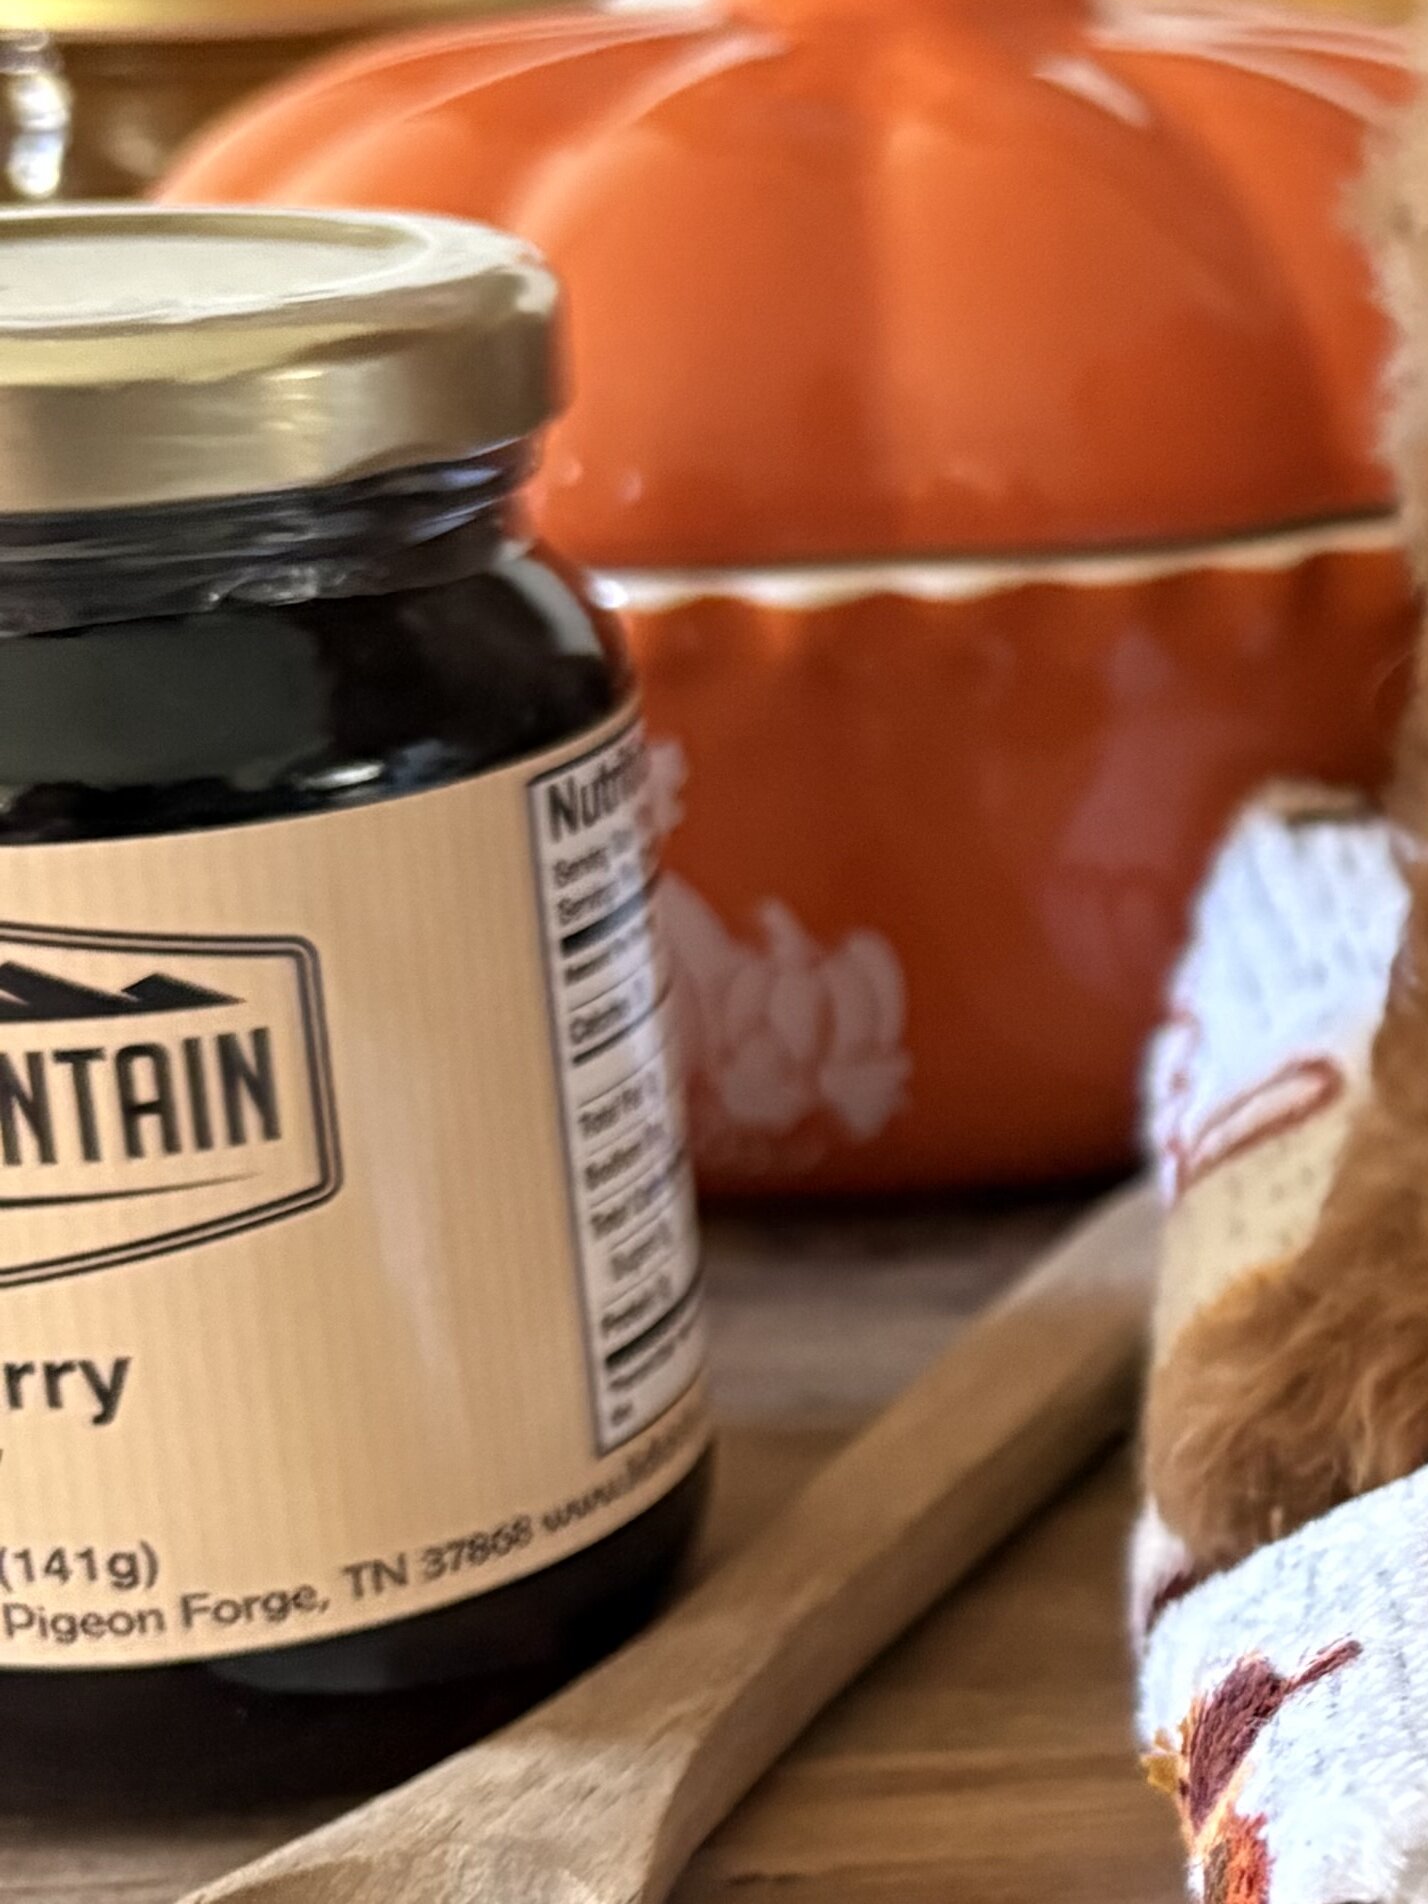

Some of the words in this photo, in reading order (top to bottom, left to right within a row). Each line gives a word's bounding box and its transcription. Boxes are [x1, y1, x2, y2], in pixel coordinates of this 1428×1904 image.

[0, 1028, 281, 1165] NTAIN
[3, 1357, 131, 1425] rry
[0, 1540, 158, 1591] (141g)
[3, 1602, 165, 1643] Pigeon
[182, 1584, 331, 1628] Forge,
[345, 1553, 407, 1598] TN
